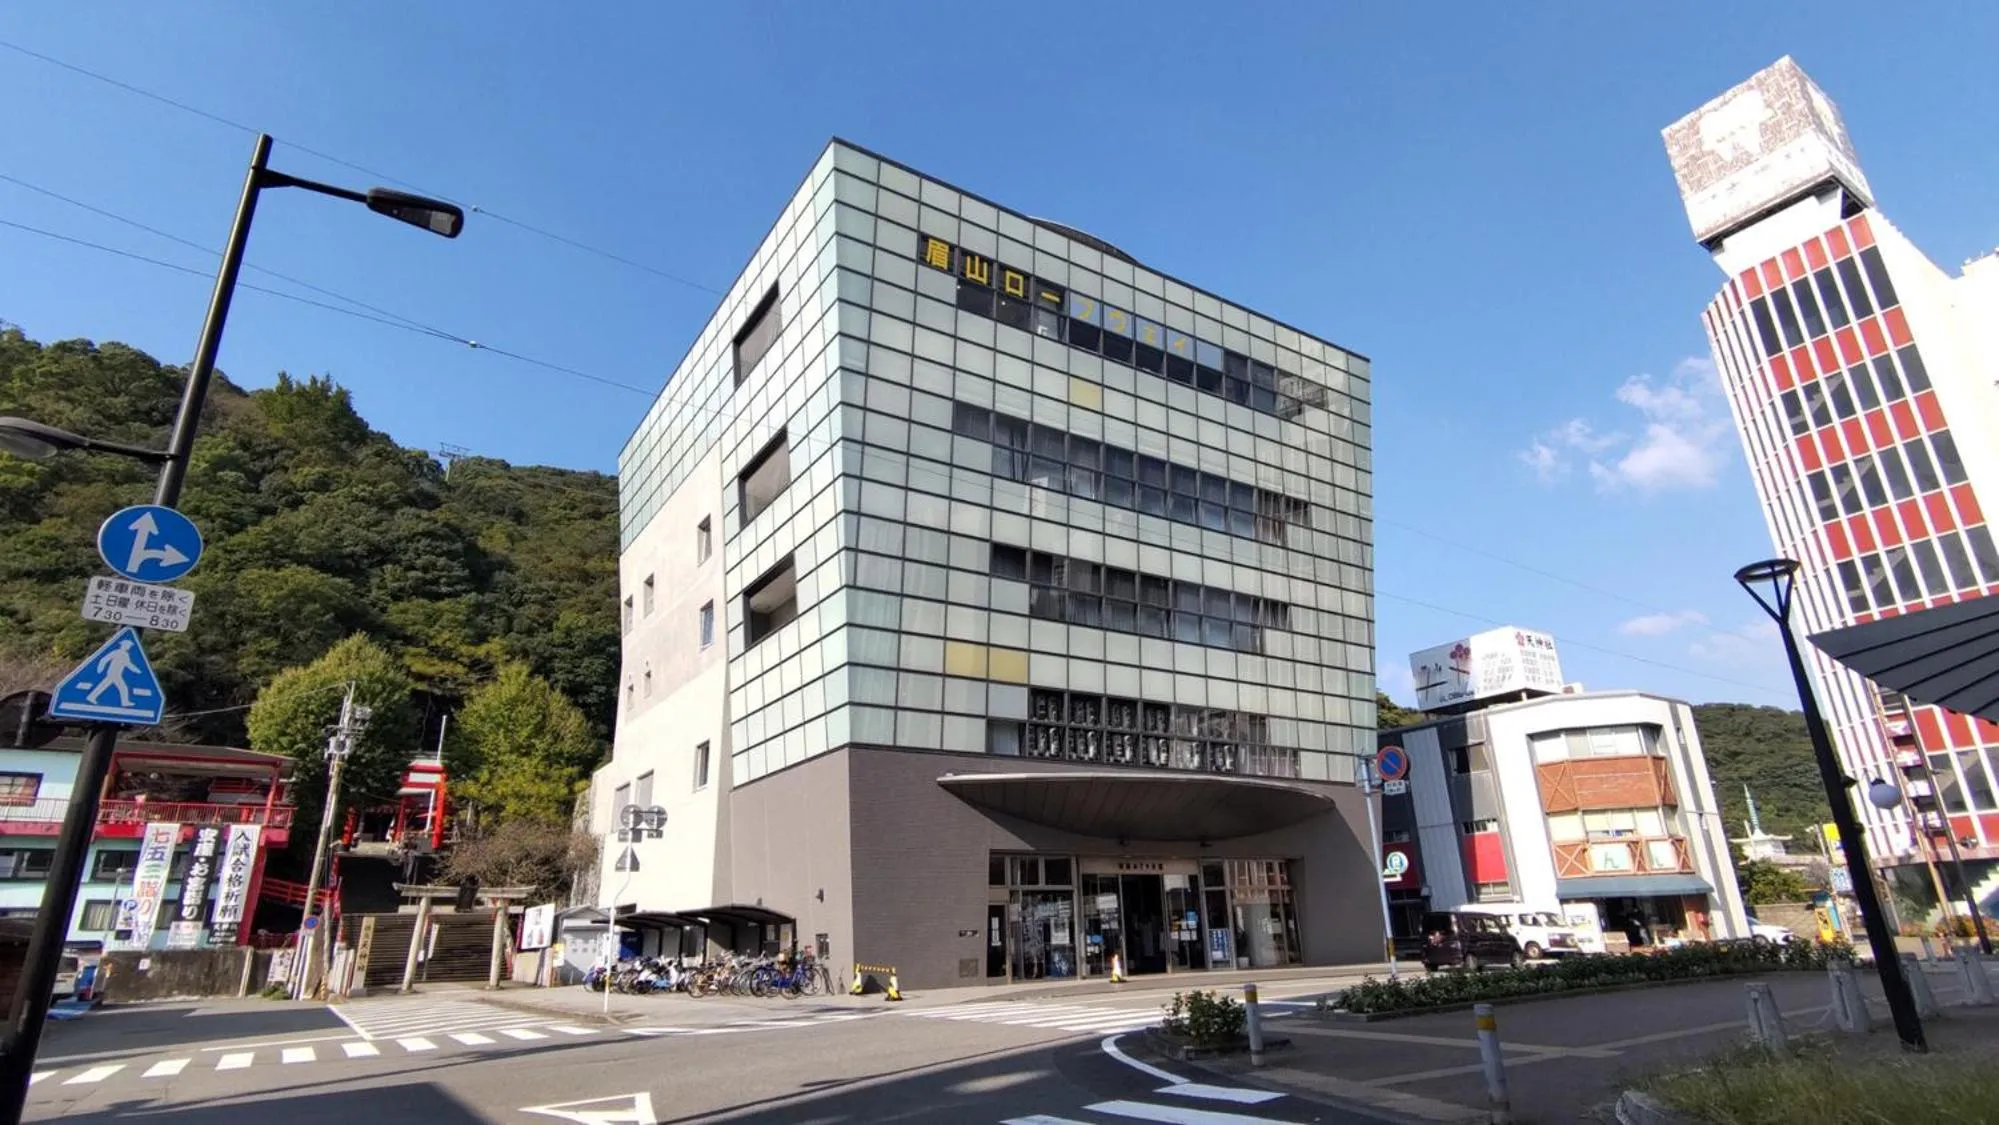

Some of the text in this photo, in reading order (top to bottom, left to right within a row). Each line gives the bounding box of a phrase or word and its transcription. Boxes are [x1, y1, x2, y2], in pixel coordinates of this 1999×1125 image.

[97, 580, 188, 604] 軽車両を除く
